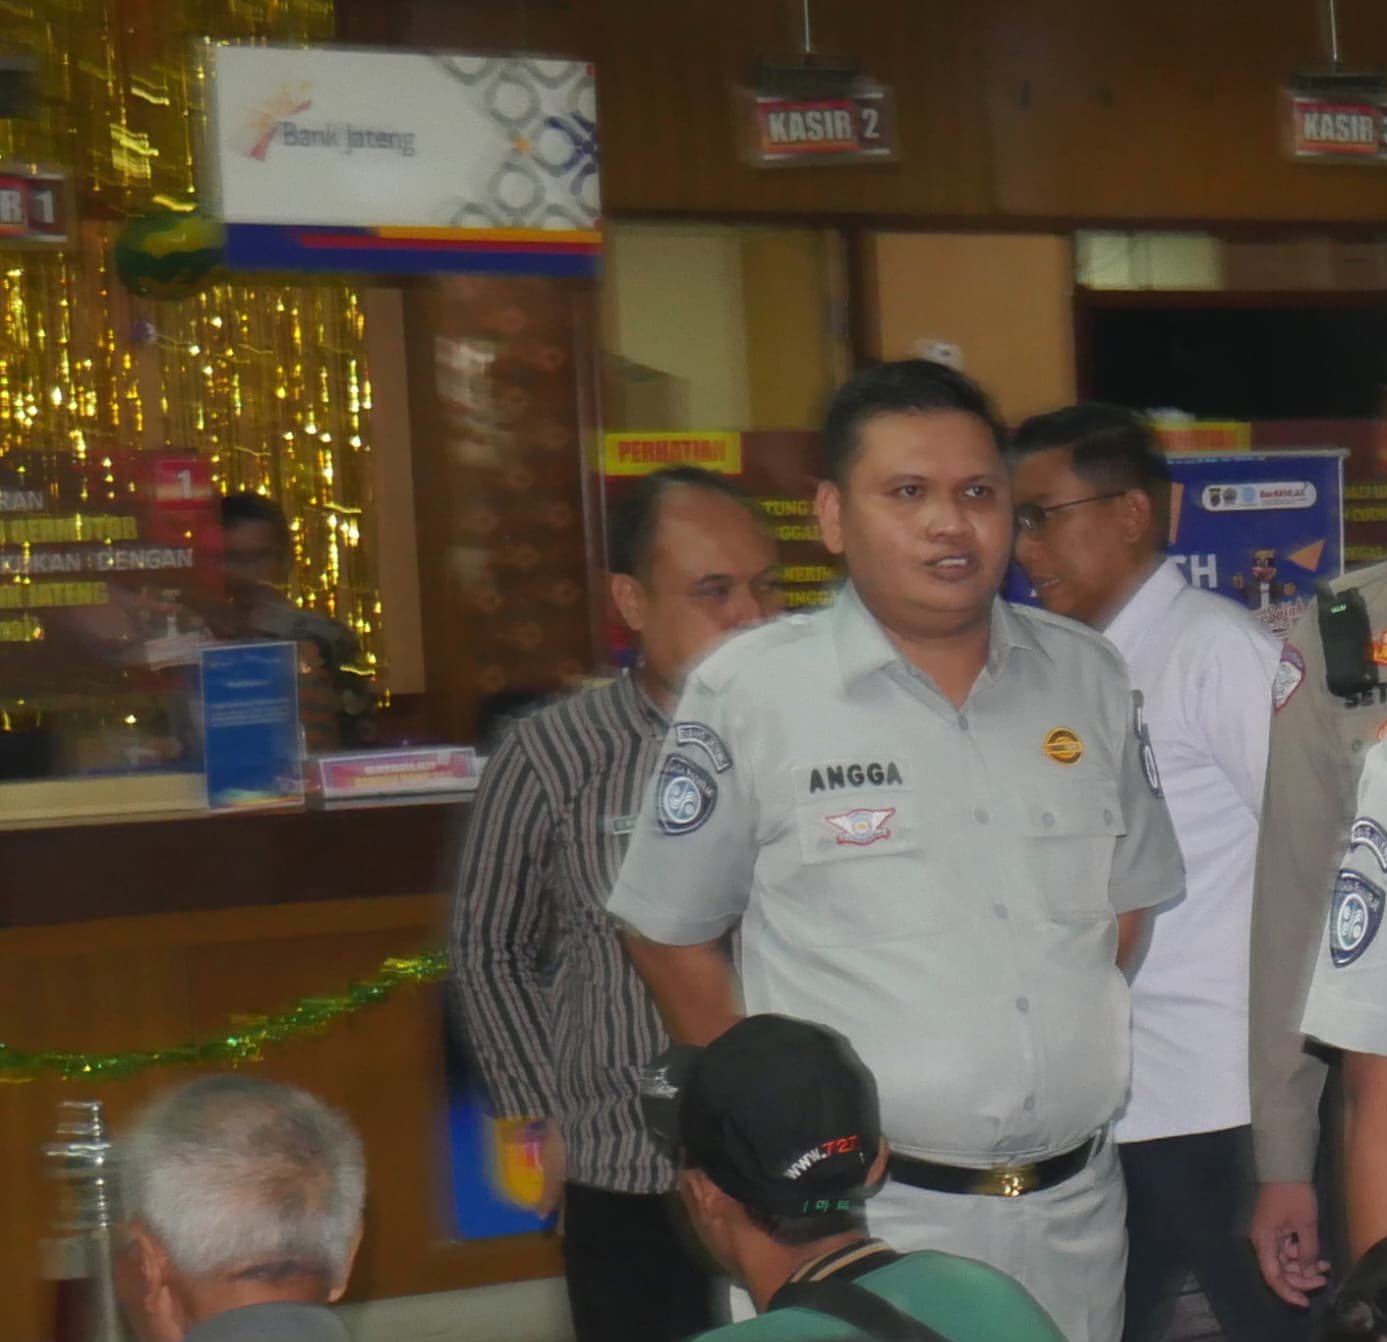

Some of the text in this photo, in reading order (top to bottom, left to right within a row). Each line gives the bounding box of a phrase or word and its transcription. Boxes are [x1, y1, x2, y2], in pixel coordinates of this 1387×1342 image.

[282, 120, 338, 147] Bank
[769, 108, 881, 143] KASIR 2
[1304, 112, 1374, 142] KASIR
[37, 190, 54, 224] 1
[176, 470, 194, 498] 1
[98, 548, 193, 573] DENGAN
[809, 761, 903, 793] ANGGA
